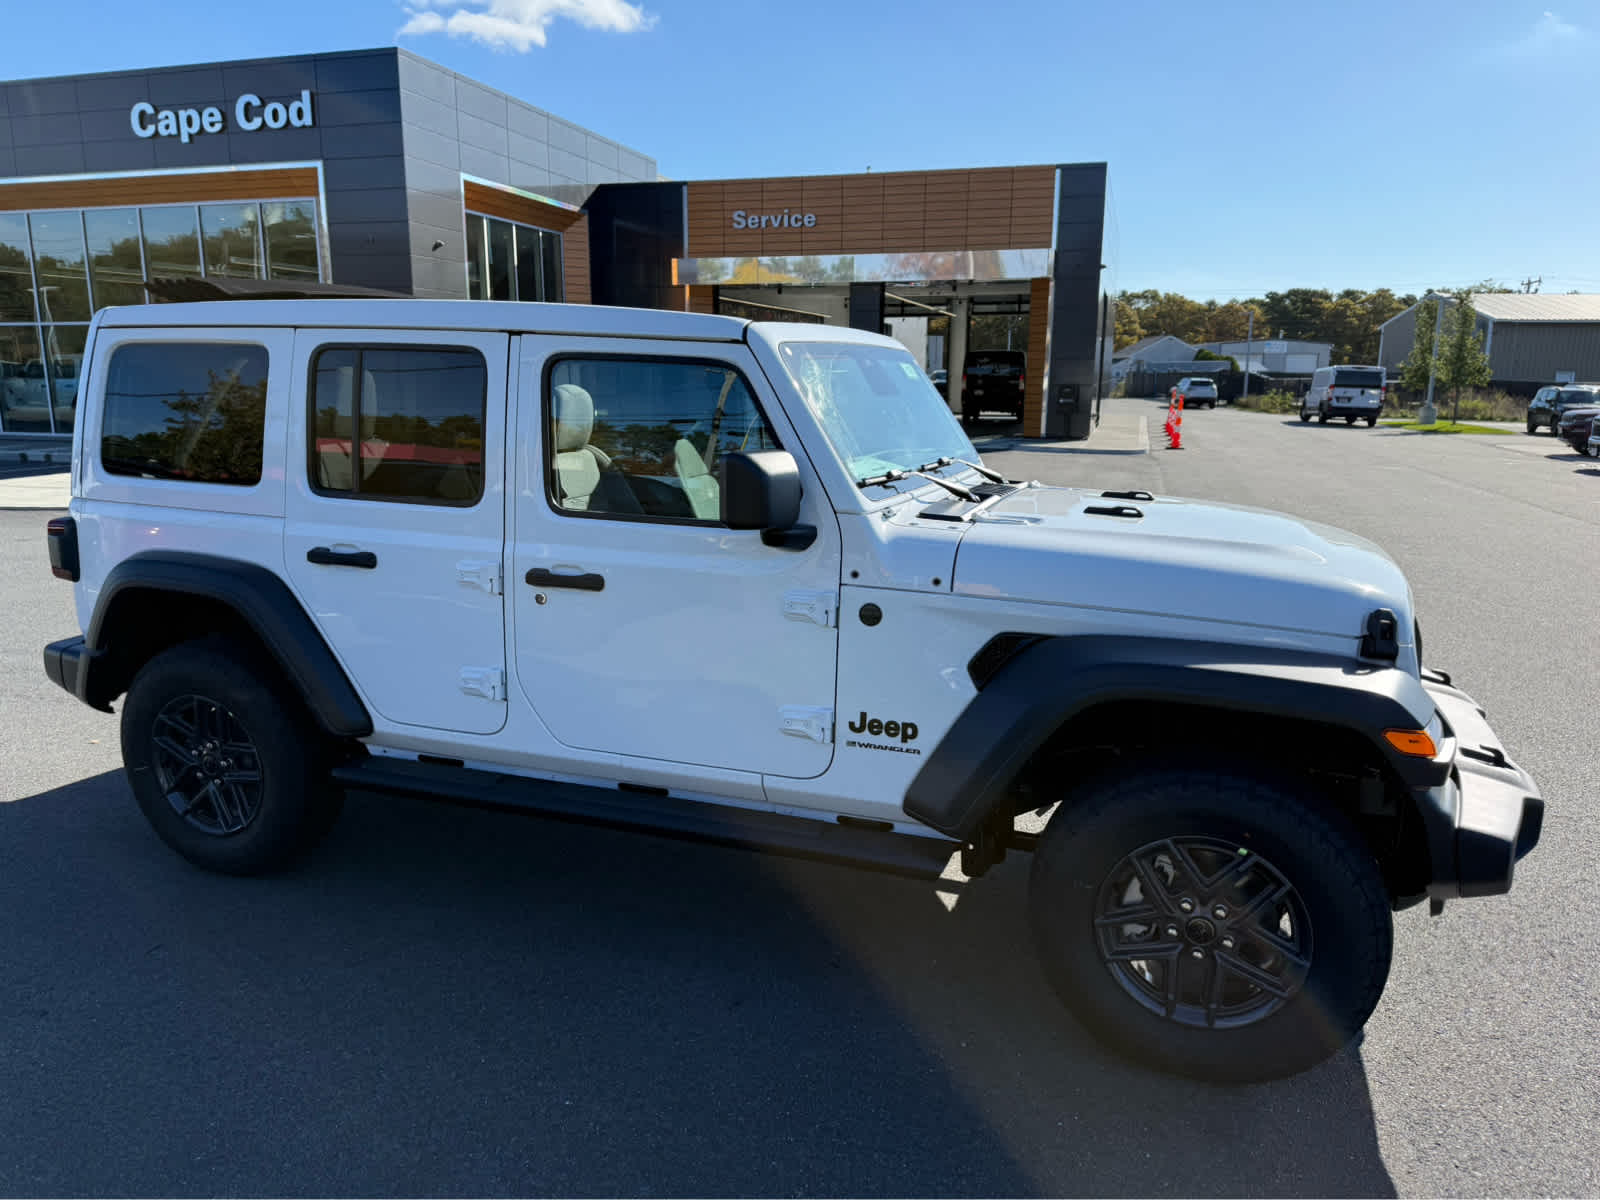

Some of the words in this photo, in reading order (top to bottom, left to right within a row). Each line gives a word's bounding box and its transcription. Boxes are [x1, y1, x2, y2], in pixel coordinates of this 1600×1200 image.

[130, 102, 223, 143] Cape
[235, 89, 313, 131] Cod
[732, 208, 816, 229] Service
[848, 711, 918, 743] Jeep
